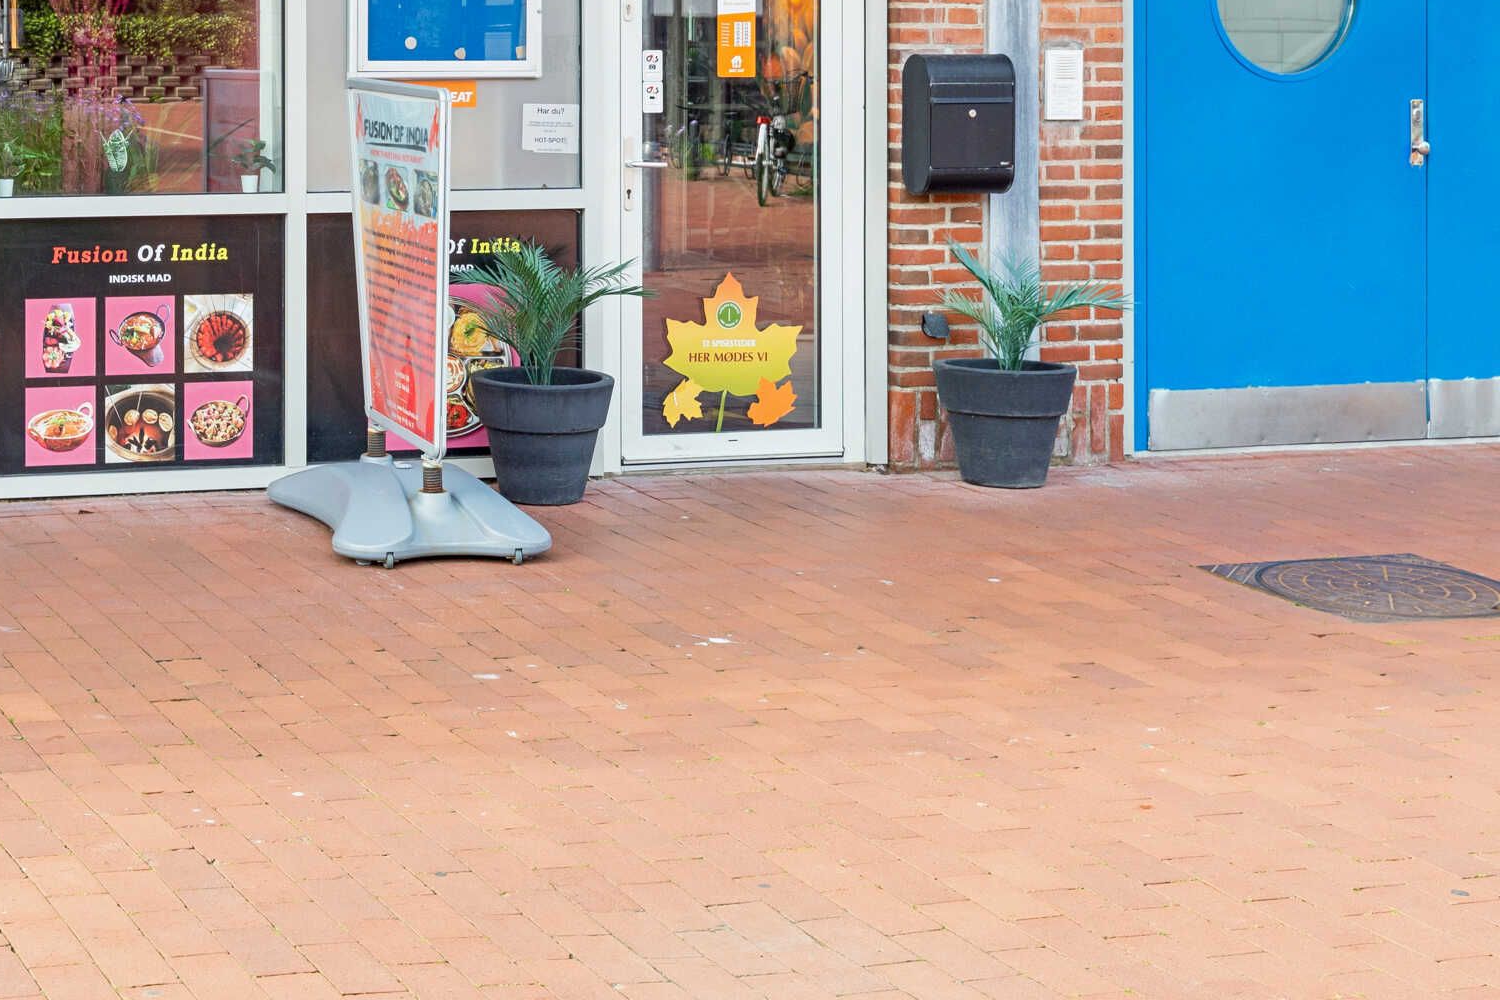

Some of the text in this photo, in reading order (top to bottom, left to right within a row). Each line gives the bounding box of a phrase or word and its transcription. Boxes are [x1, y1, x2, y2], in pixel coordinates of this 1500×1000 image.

[451, 91, 474, 103] EAT
[363, 119, 429, 147] FUSION OF INDIA
[470, 237, 521, 254] India
[51, 243, 229, 264] Fusion Of India
[146, 273, 172, 282] MAD
[688, 351, 768, 363] HER MØDES VI
